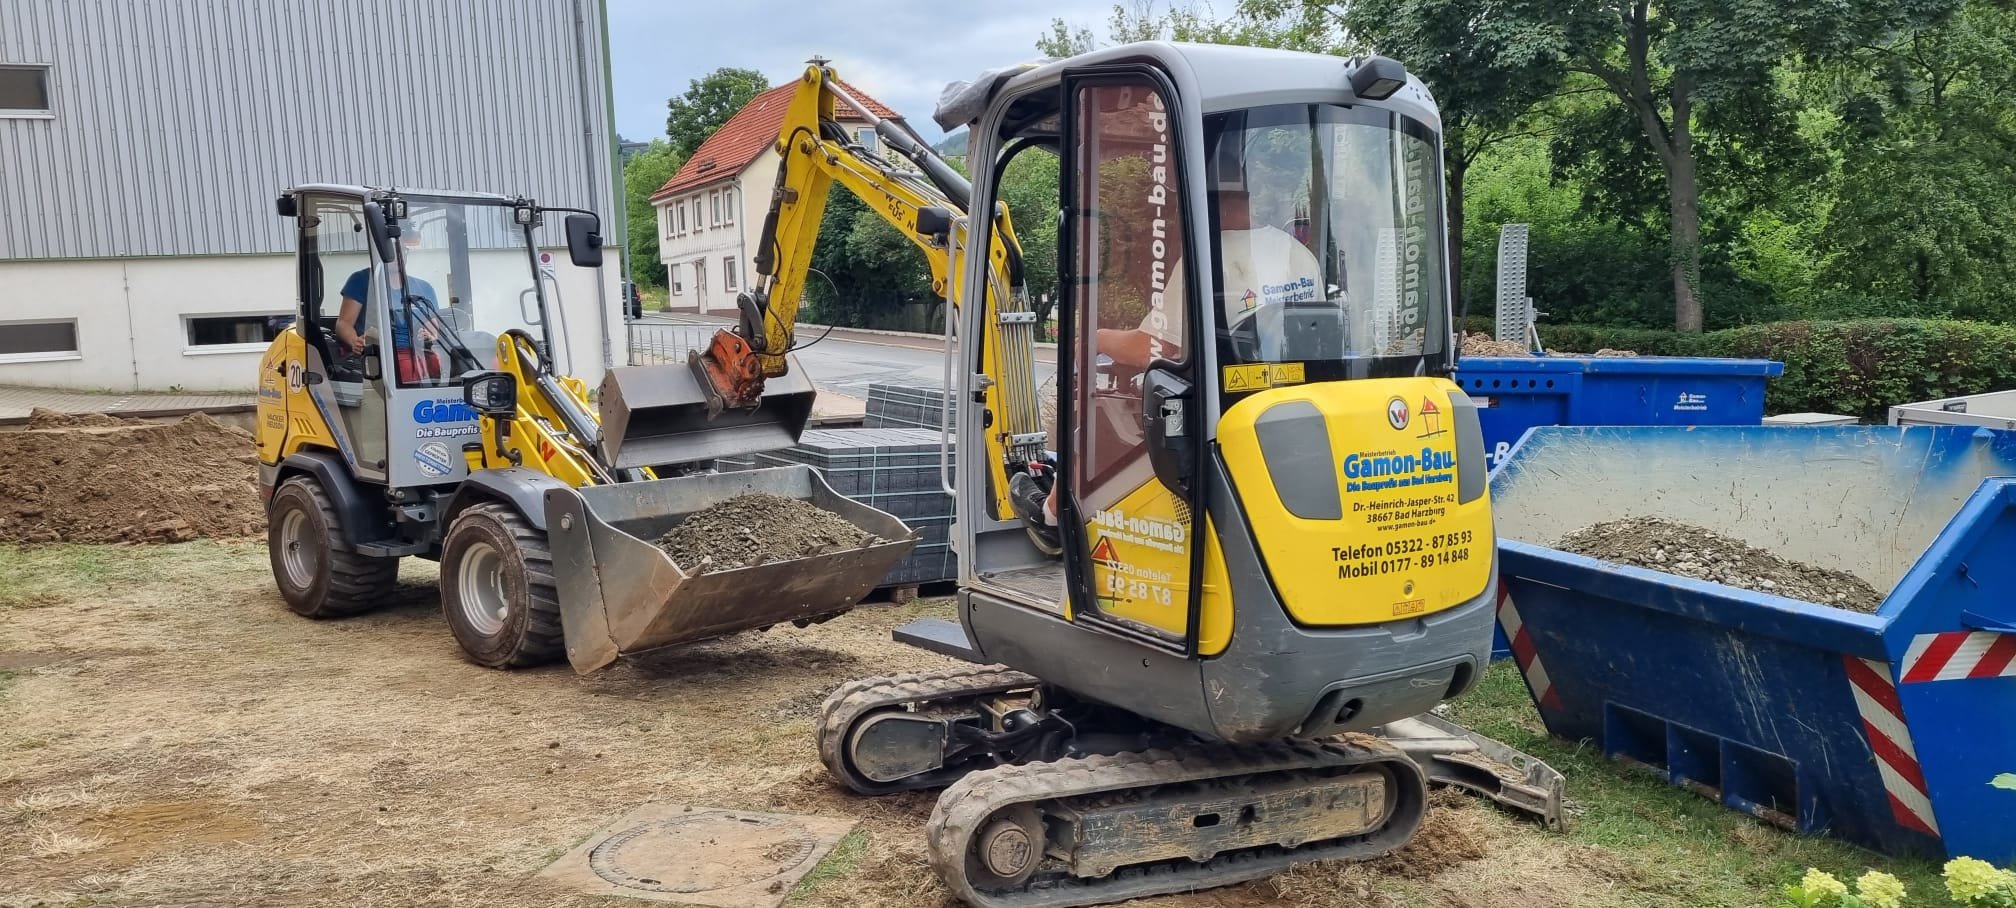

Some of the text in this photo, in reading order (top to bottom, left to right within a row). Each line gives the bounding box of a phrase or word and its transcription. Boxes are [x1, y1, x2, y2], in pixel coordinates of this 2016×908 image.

[291, 365, 300, 388] 20
[416, 428, 433, 438] Die
[434, 425, 478, 438] Bauprofis
[1359, 450, 1397, 458] Meisterbetrieb
[1347, 482, 1360, 492] Die
[1353, 493, 1455, 512] Dr.-Heinrich-Jasper-Str. 42
[1366, 506, 1445, 523] 38667 Bad Harzburg
[1377, 518, 1436, 531] www.gamon-bau.de
[1332, 544, 1383, 561] Telefon
[1386, 538, 1423, 555] 05322
[1432, 535, 1445, 549] 87
[1447, 533, 1459, 546] 85
[1461, 530, 1472, 544] 93
[1338, 561, 1378, 579] Mobil
[1381, 557, 1411, 574] 0177
[1420, 554, 1434, 568] 89
[1438, 552, 1449, 565] 14
[1452, 548, 1469, 562] 848
